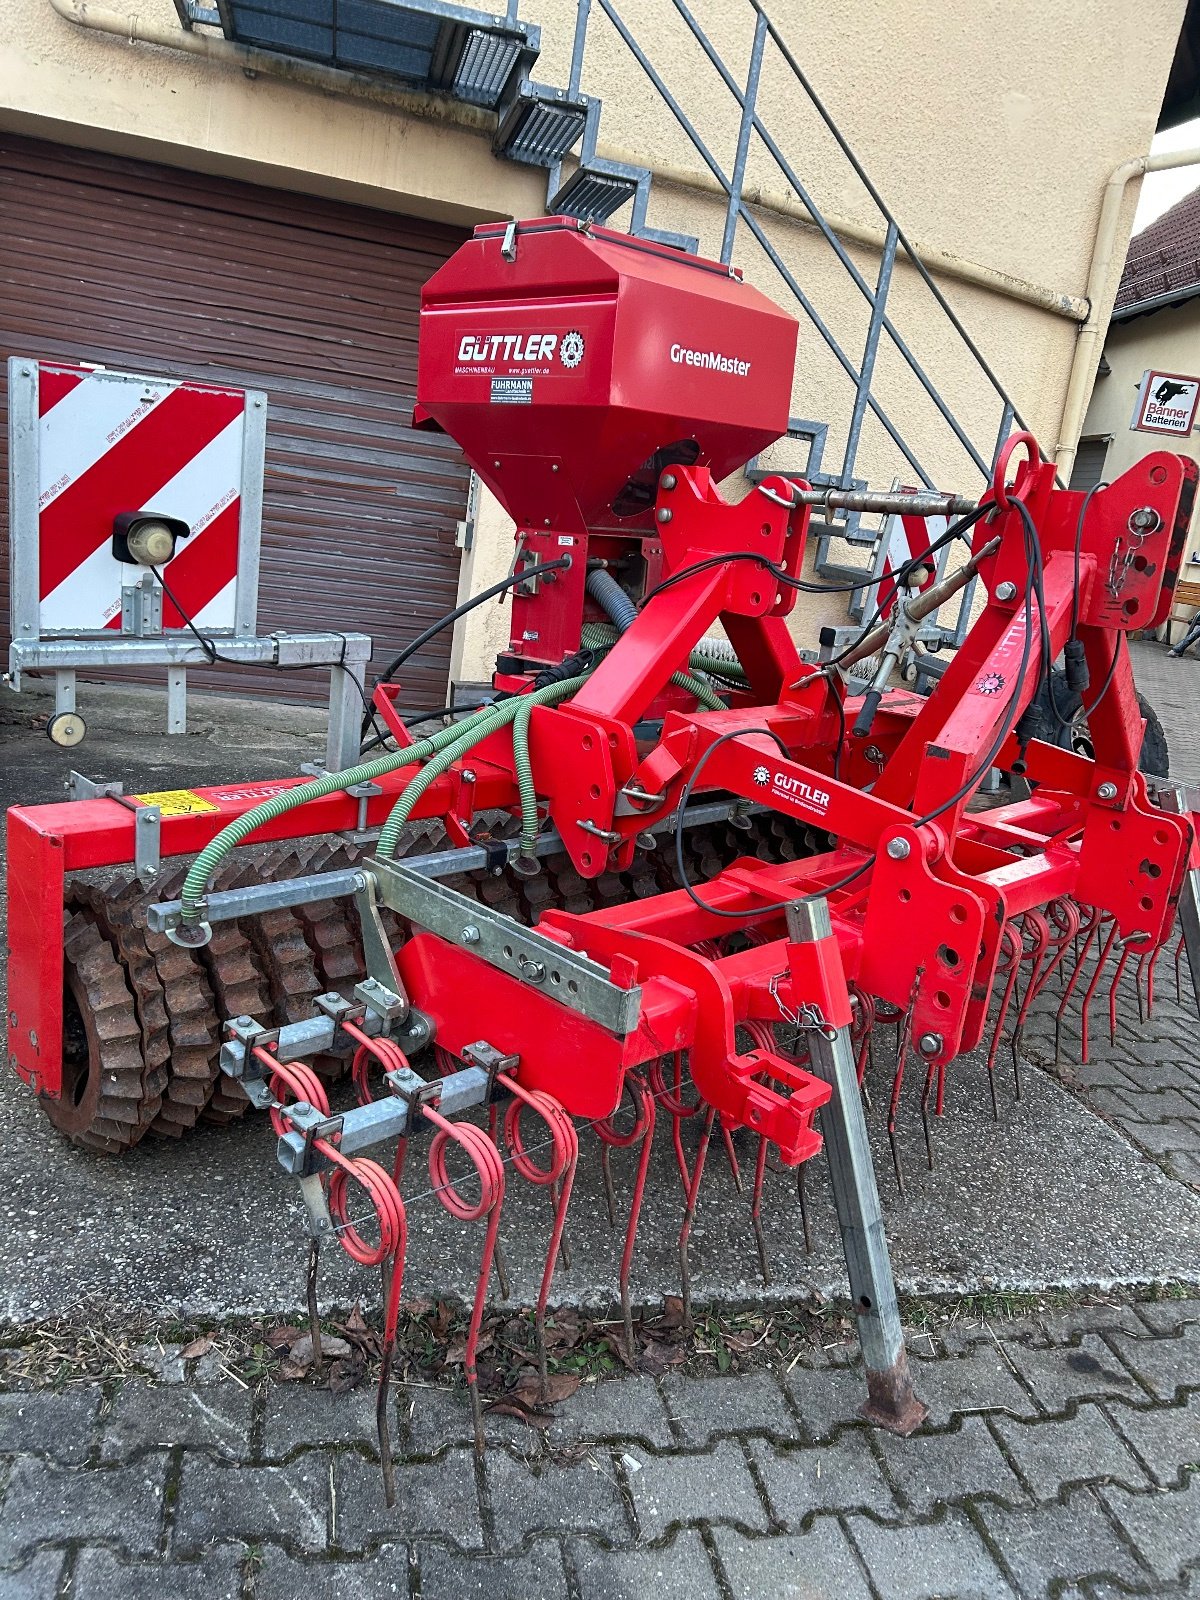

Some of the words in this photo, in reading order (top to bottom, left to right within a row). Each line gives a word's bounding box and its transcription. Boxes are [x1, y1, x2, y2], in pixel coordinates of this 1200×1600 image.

[458, 334, 558, 361] GÜTTLER
[454, 366, 496, 374] MASCHINENBAU
[670, 343, 751, 376] GreenMaster
[1145, 413, 1186, 428] Batterien
[1147, 402, 1189, 418] Banner
[774, 772, 830, 807] GÜTTLER
